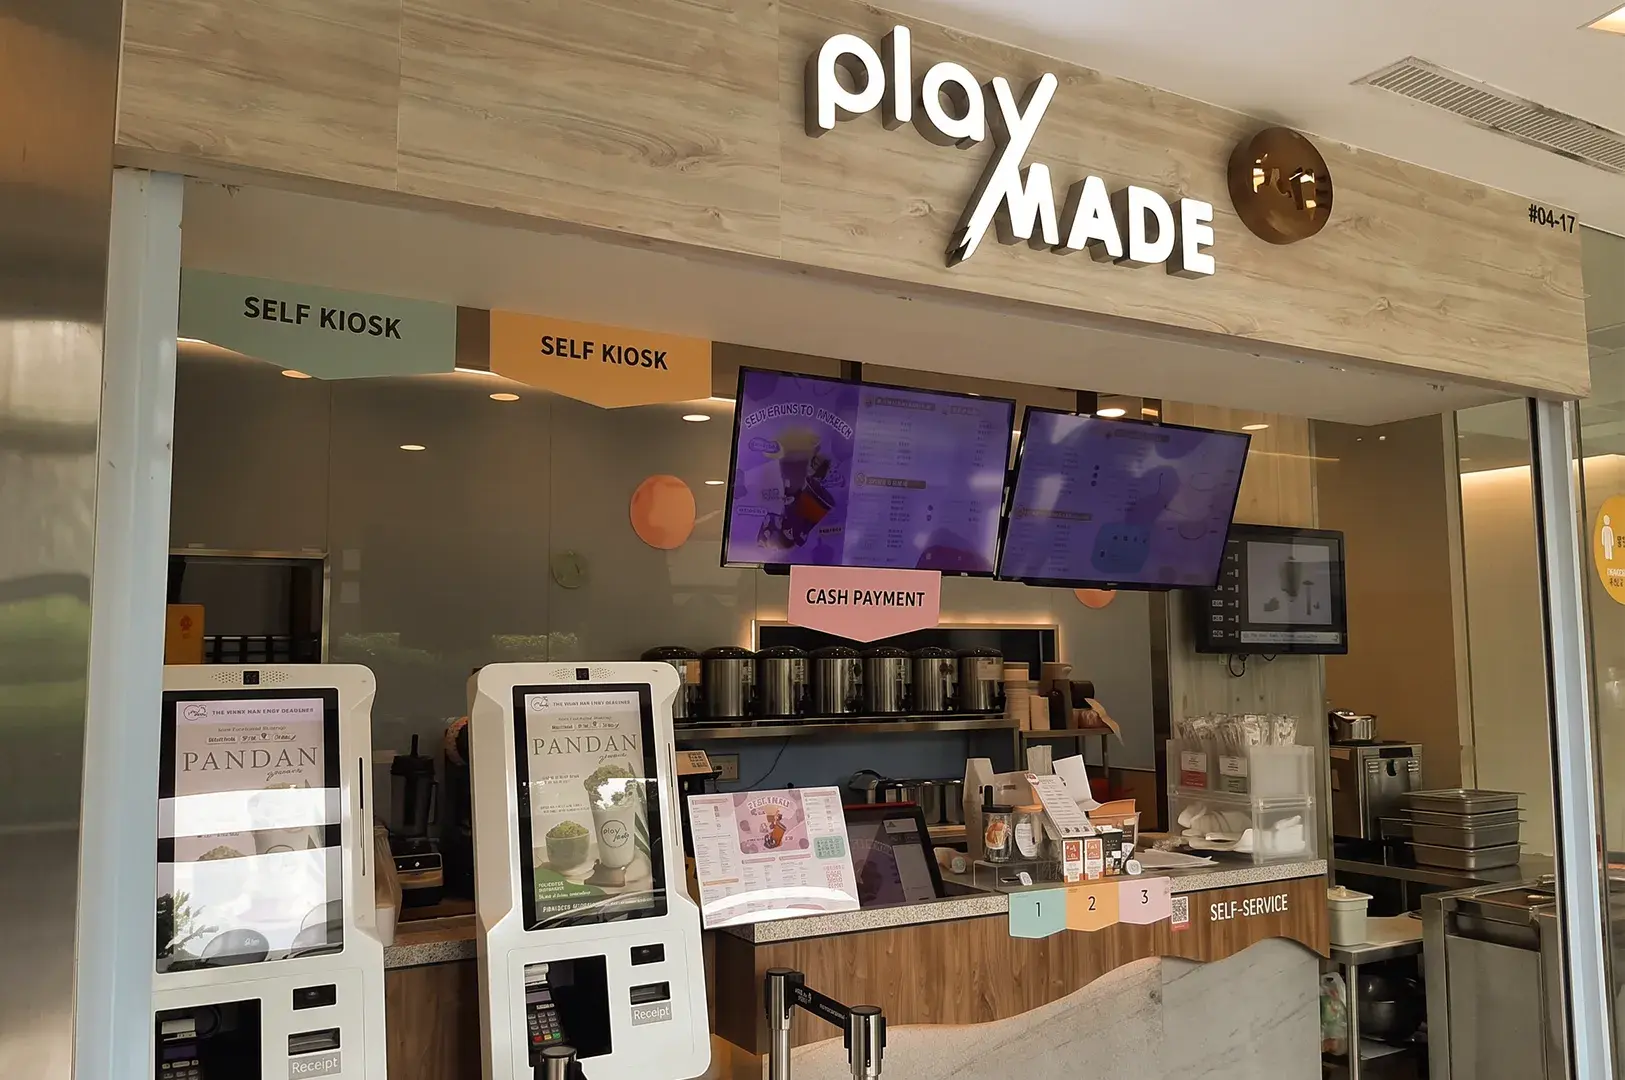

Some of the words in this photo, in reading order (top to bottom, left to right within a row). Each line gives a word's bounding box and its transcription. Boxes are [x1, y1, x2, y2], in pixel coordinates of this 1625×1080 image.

[994, 162, 1217, 276] MADE
[1528, 203, 1576, 234] #04-17
[243, 296, 311, 325] SELF
[320, 307, 402, 340] KIOSK
[540, 335, 595, 360] SELF
[602, 343, 668, 371] KIOSK
[806, 588, 849, 605] CASH
[853, 589, 926, 607] PAYMENT
[532, 733, 638, 756] PANDAN
[182, 746, 318, 772] PANDAN
[1088, 896, 1096, 911] 2
[1141, 889, 1149, 904] 3
[1210, 893, 1288, 922] SELF-SERVICE
[1035, 901, 1042, 918] 1
[633, 1005, 671, 1021] Receipt
[292, 1056, 339, 1075] Receipt
